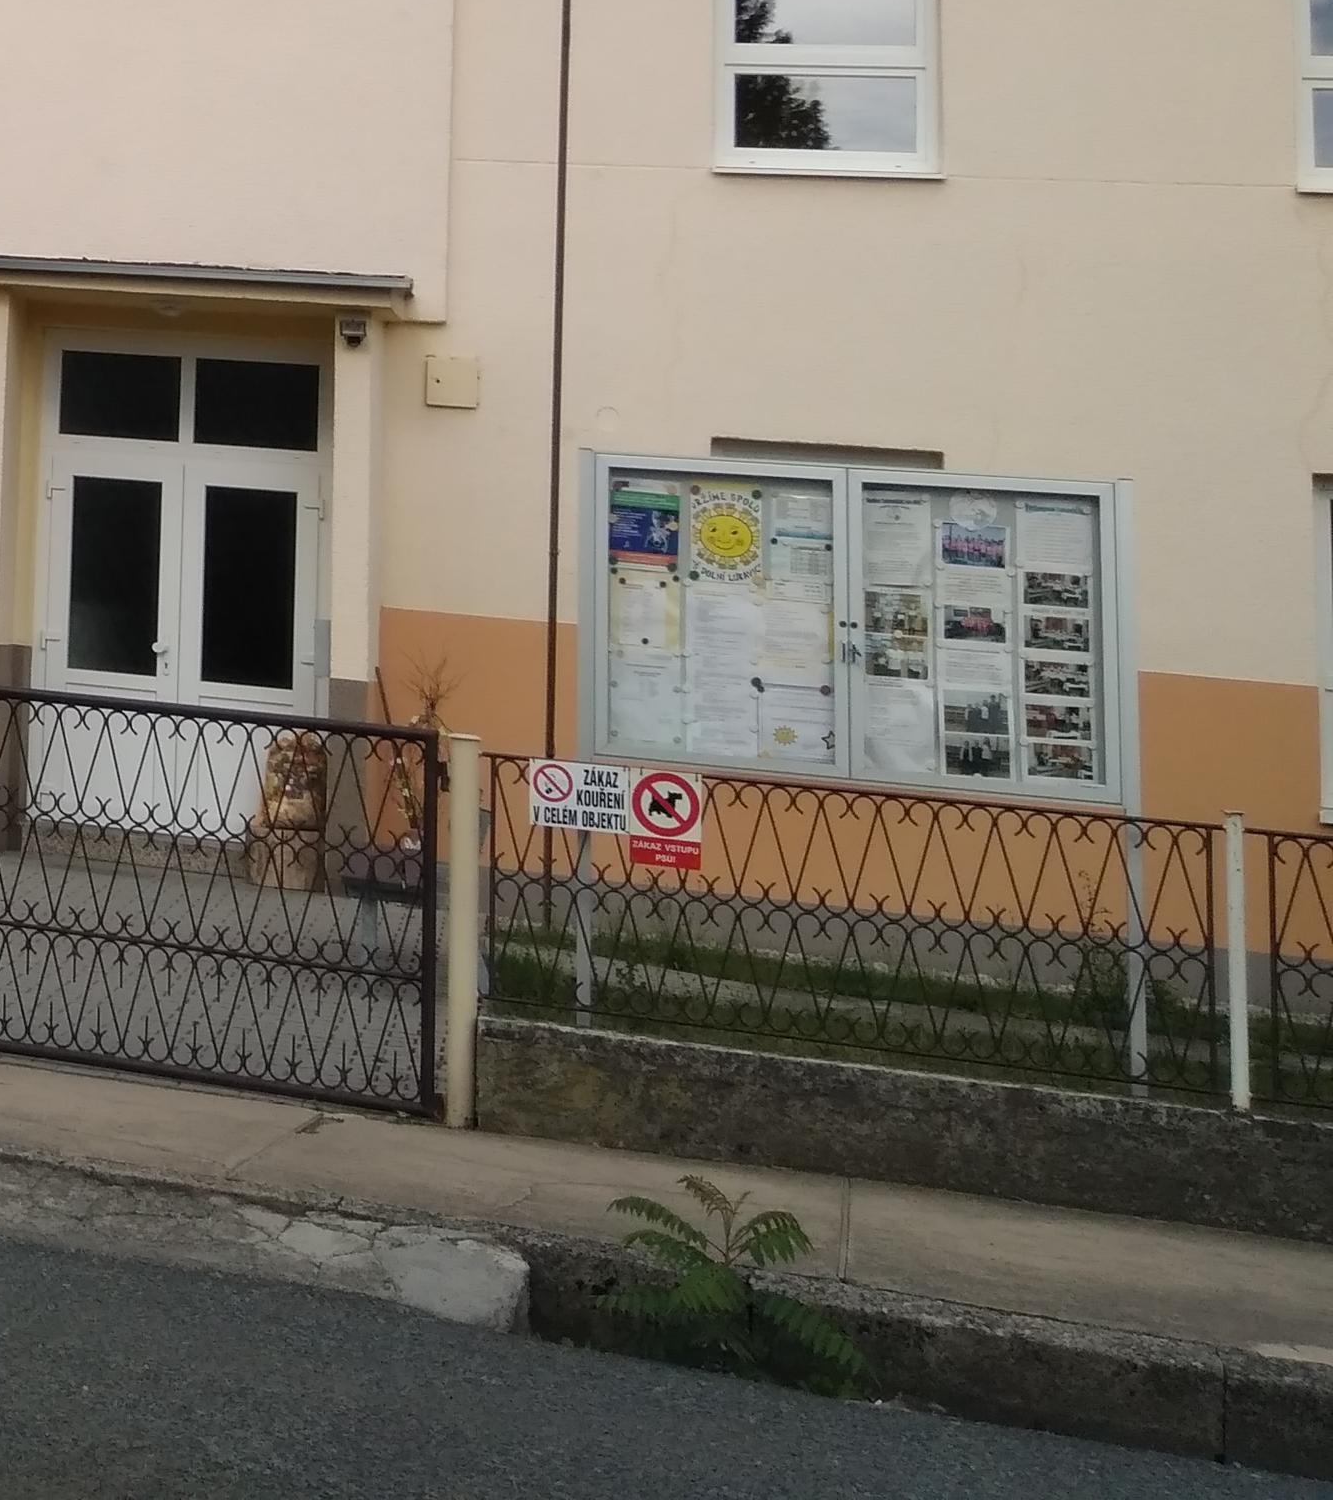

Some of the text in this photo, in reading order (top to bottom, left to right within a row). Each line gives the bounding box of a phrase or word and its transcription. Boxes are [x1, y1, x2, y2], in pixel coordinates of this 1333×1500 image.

[583, 767, 619, 788] ZÁKAZ
[576, 787, 626, 810] KOUŘENÍ
[533, 805, 627, 831] V CELÉM OBJEKTU
[664, 843, 700, 855] VSTUPU
